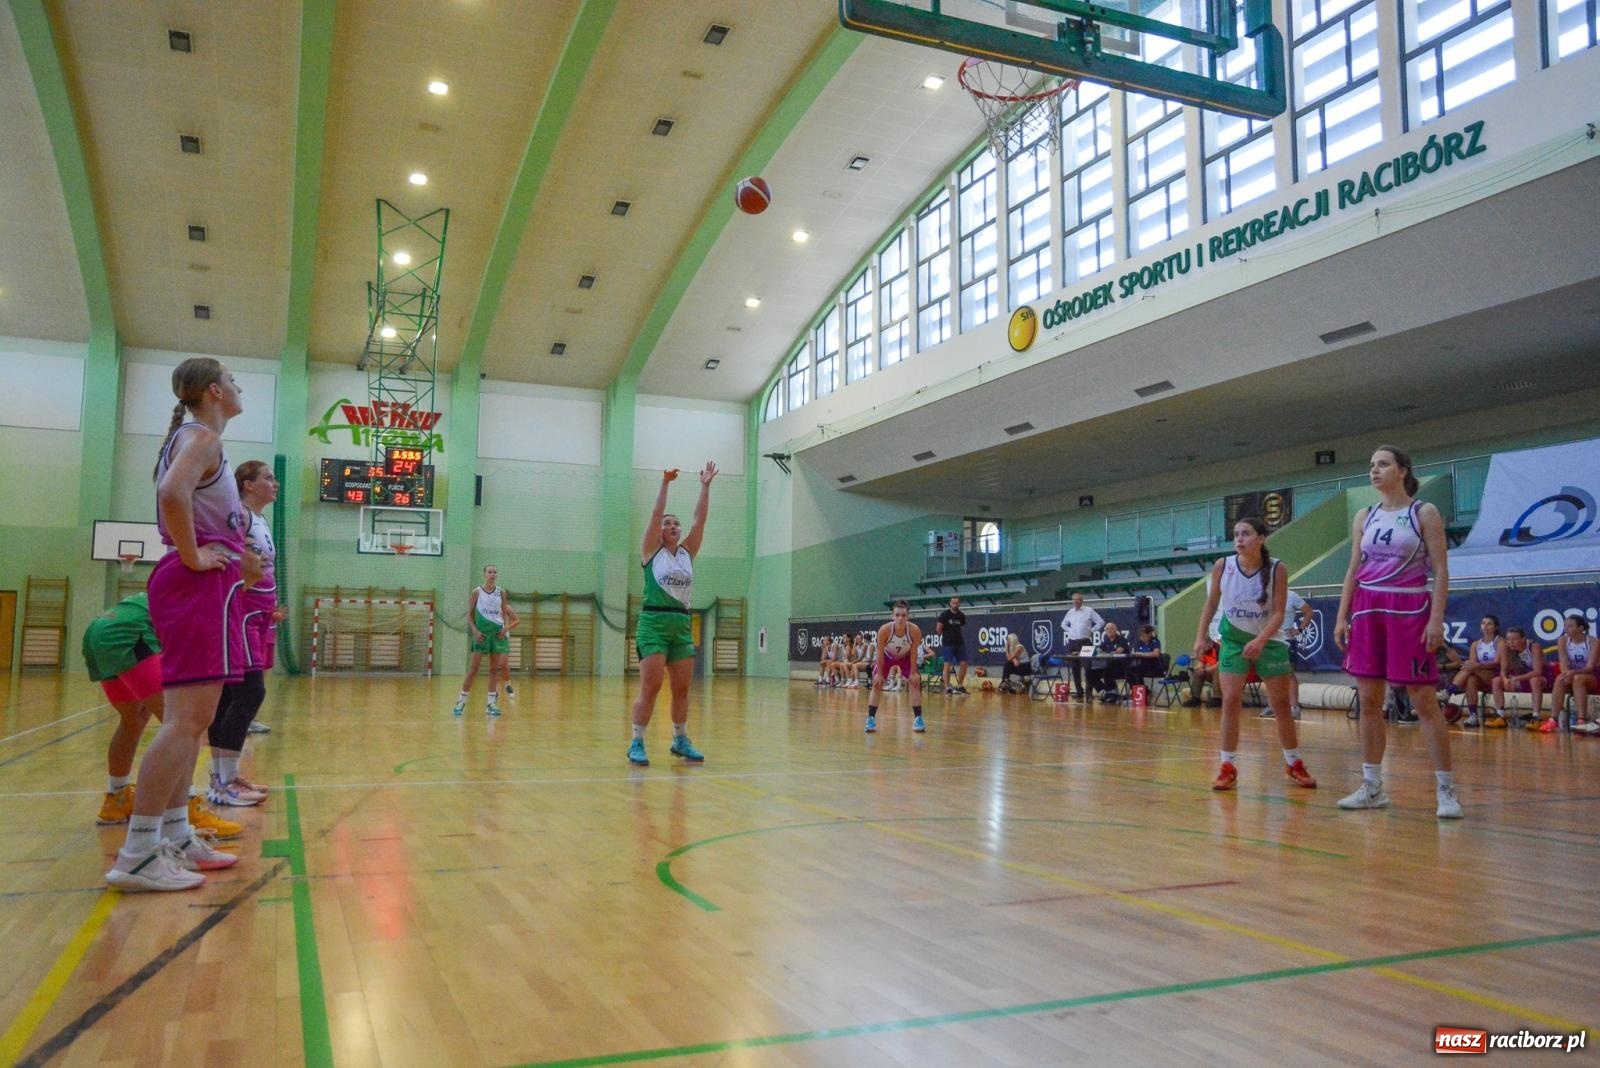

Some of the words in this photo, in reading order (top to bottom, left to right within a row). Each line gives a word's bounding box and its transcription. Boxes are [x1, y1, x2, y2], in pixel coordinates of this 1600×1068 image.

[1042, 284, 1115, 330] OŚRODEK
[1118, 248, 1191, 299] SPORTU
[1196, 243, 1204, 268] I
[1209, 188, 1330, 263] REKREACJI
[1337, 120, 1488, 210] RACIBÓRZ
[393, 460, 414, 473] 24
[347, 490, 364, 501] 43
[395, 492, 410, 504] 26
[1372, 528, 1394, 545] 14
[979, 627, 1008, 646] OSiR
[1482, 652, 1489, 661] 6
[1412, 656, 1430, 679] 14
[1134, 687, 1143, 701] 5
